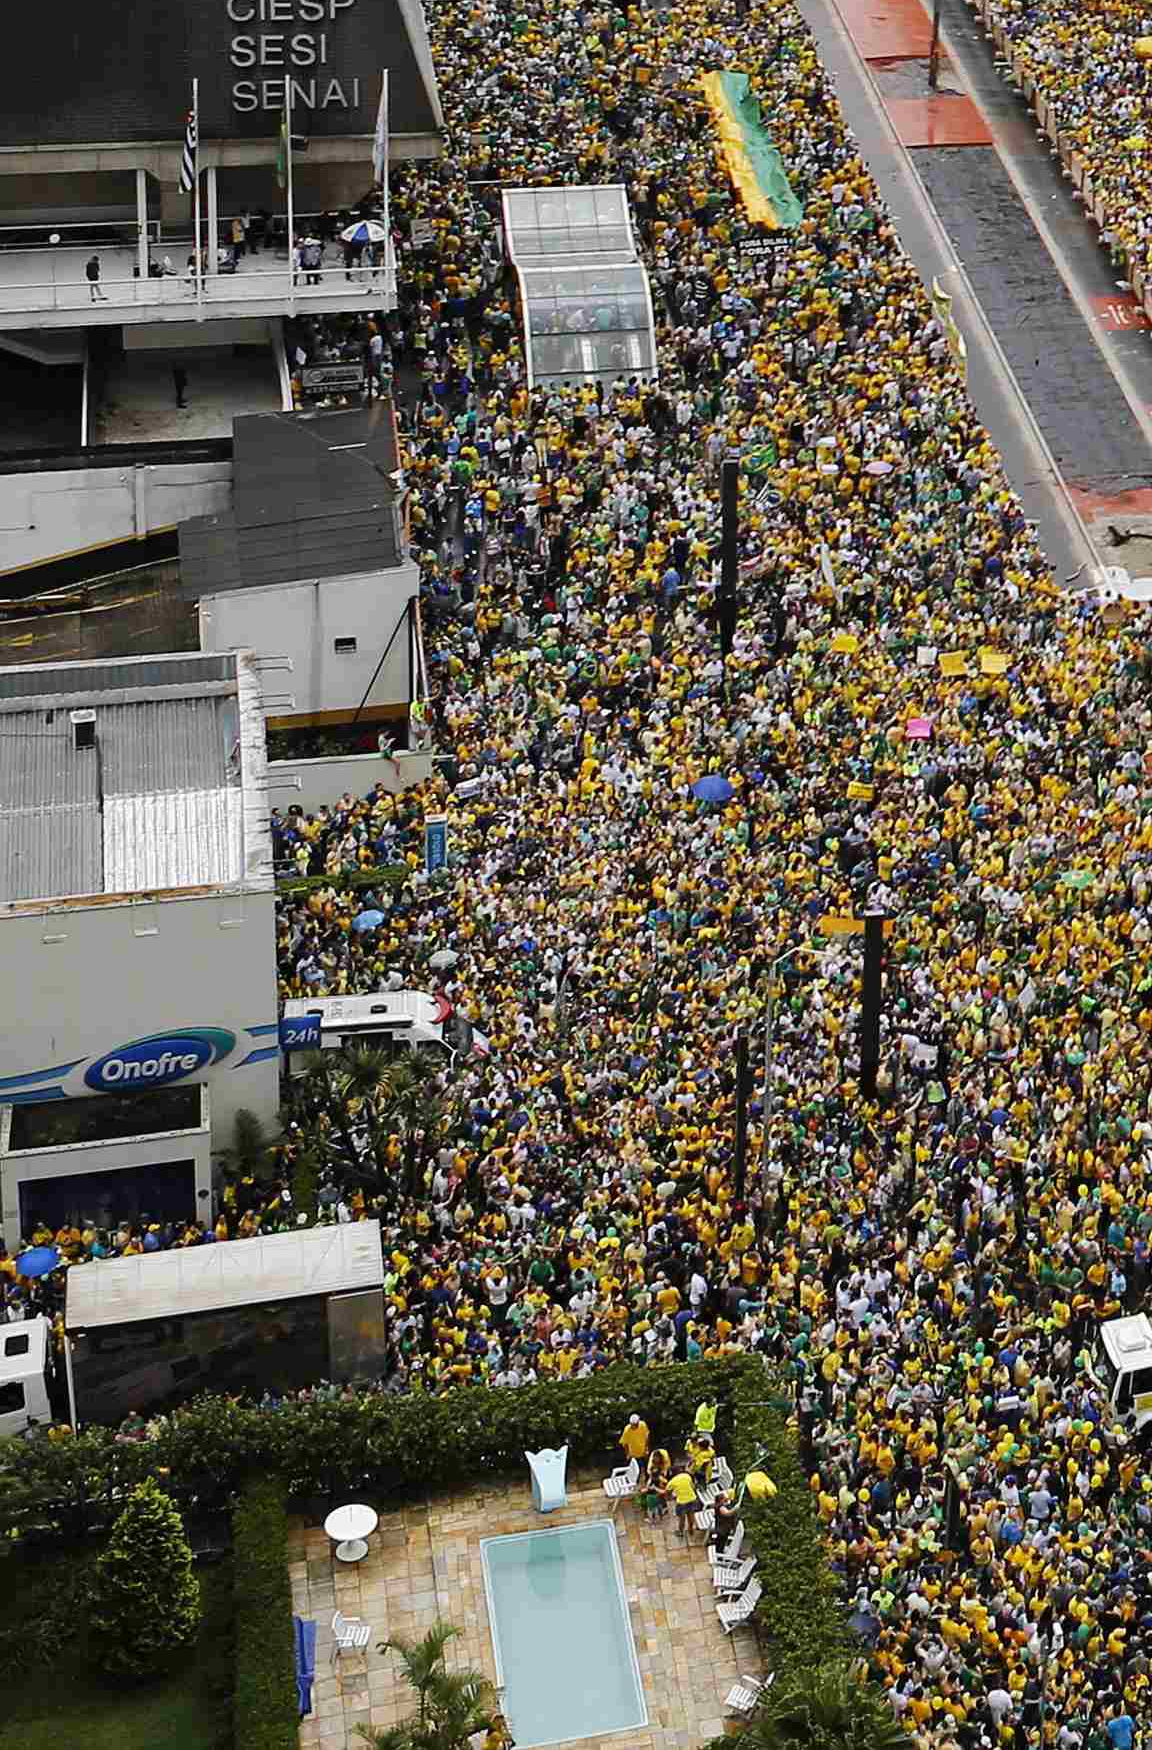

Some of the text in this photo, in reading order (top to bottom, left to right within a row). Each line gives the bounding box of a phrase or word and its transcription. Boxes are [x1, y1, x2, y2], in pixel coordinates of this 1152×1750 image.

[230, 34, 326, 67] SESI
[232, 78, 359, 111] SENAI
[284, 1029, 318, 1045] 24h
[101, 1051, 199, 1082] Onofre
